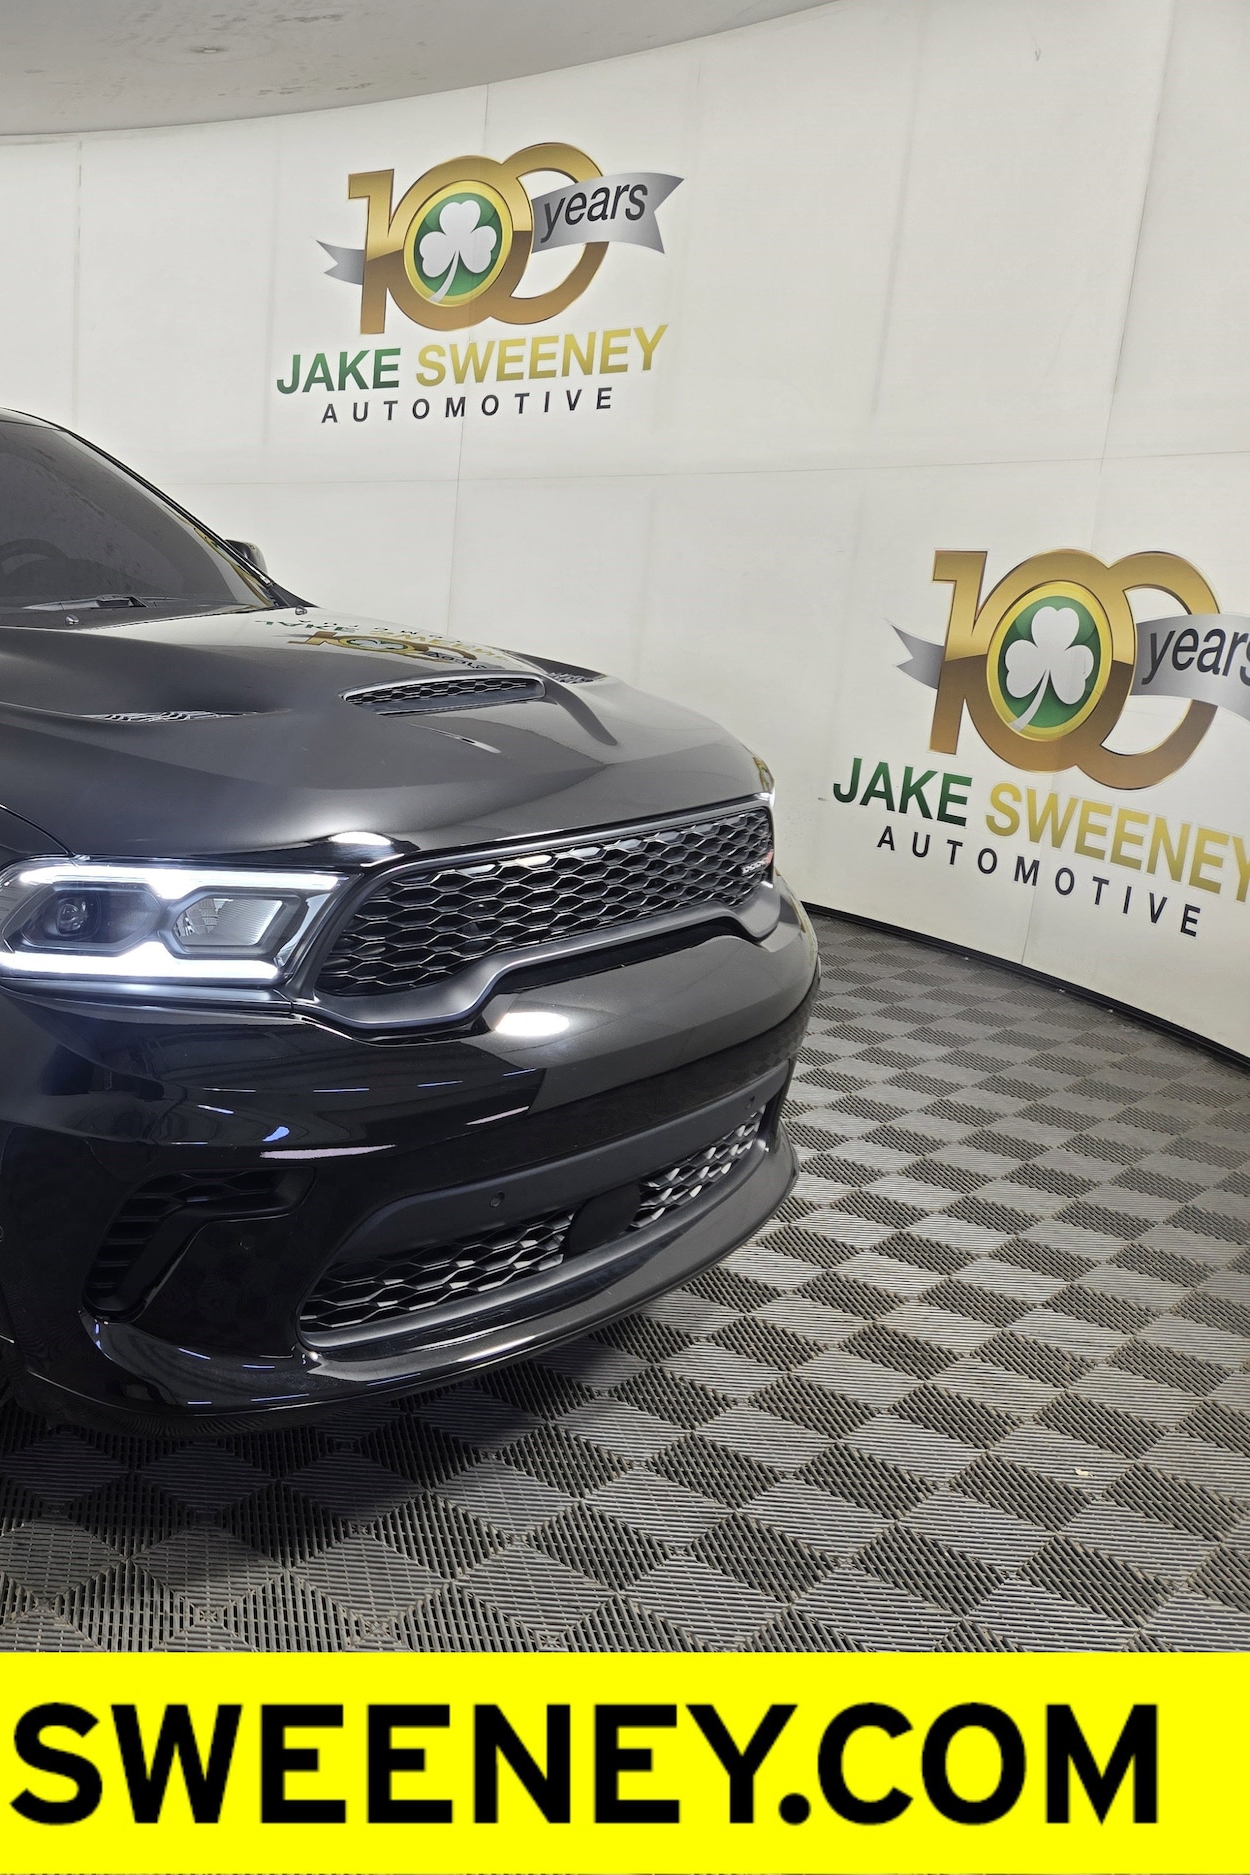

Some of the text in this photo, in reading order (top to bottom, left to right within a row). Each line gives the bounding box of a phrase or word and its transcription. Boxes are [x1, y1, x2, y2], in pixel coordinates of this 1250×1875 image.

[348, 142, 648, 335] 100 years
[276, 324, 669, 395] JAKE SWEENEY
[321, 387, 612, 424] AUTOMOTIVE
[929, 549, 1222, 791] 100
[833, 757, 973, 827] JAKE
[877, 825, 1202, 938] AUTOMOTIVE
